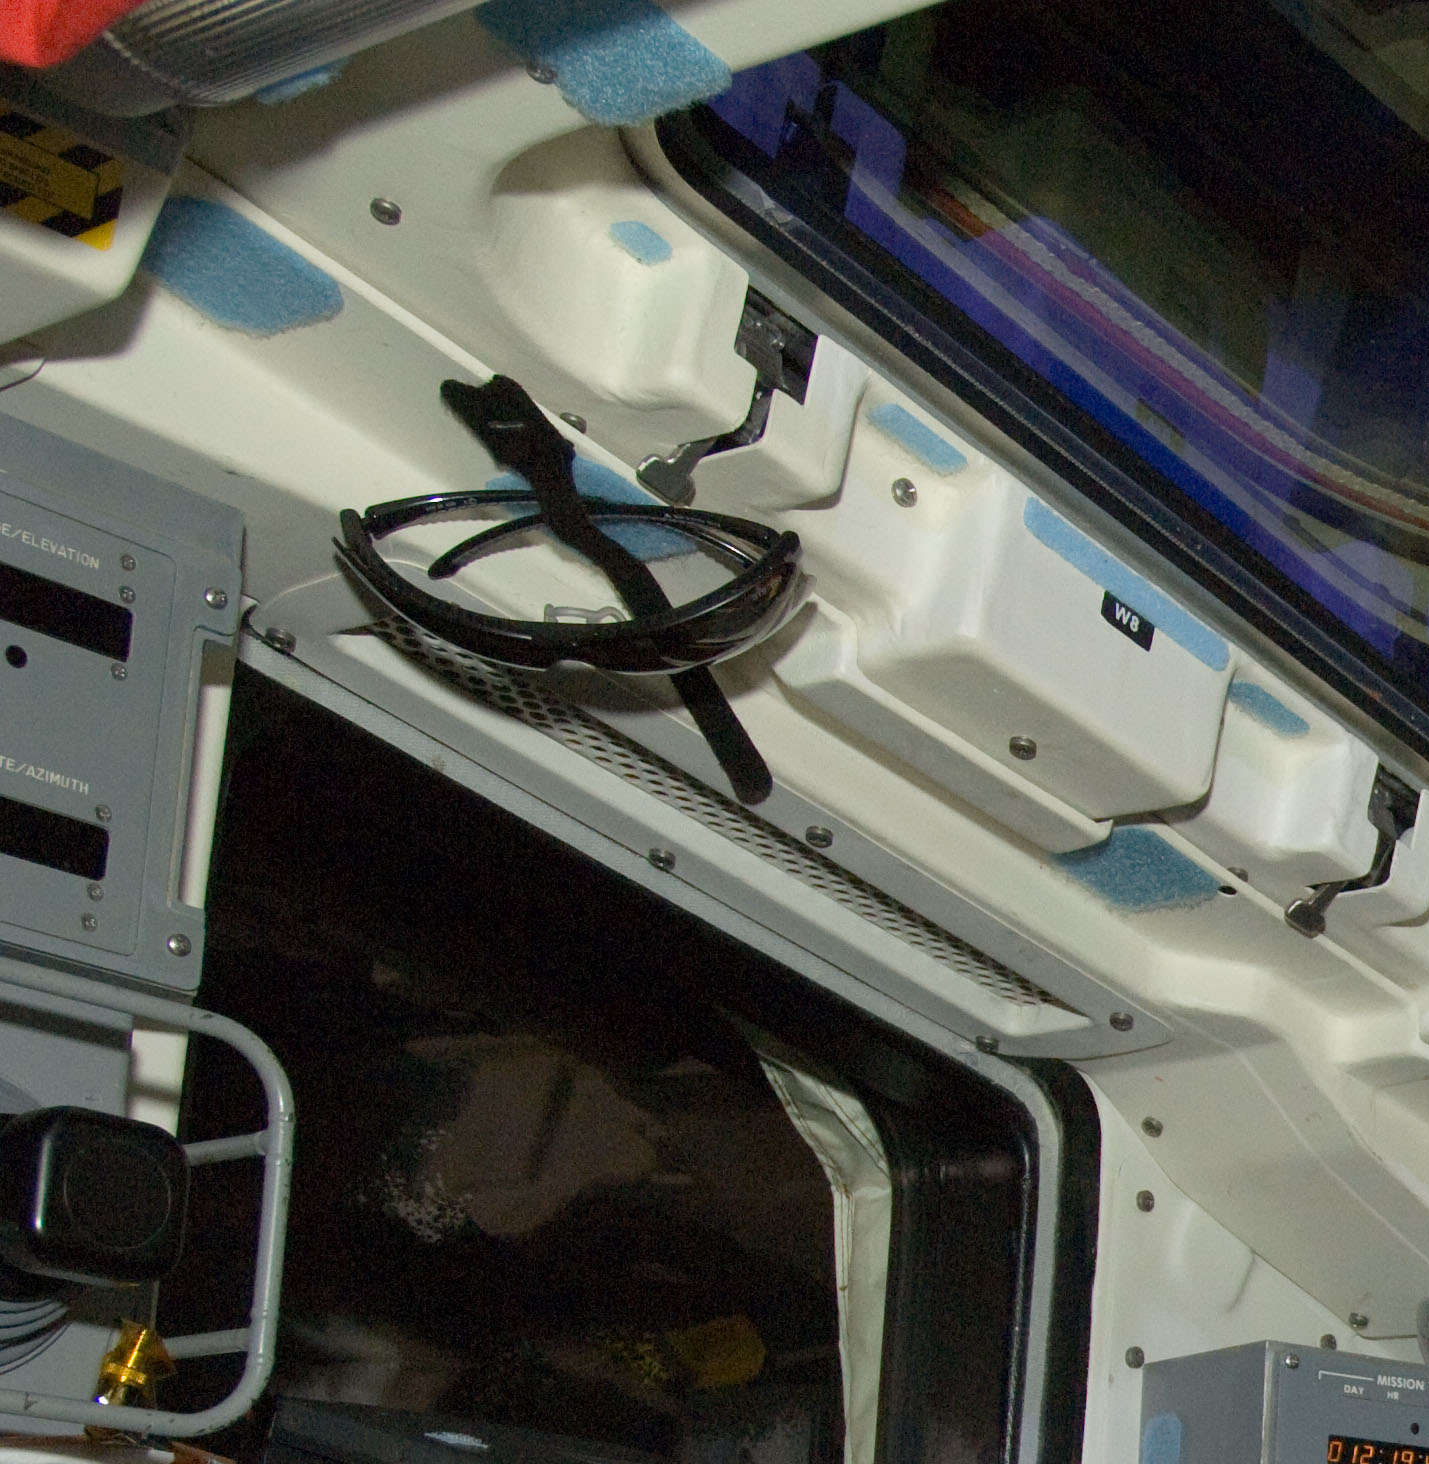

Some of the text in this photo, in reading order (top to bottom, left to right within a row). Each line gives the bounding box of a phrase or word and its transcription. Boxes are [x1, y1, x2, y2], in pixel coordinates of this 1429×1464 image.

[1115, 602, 1140, 632] W8
[1377, 1375, 1424, 1390] MISSION
[1344, 1385, 1364, 1396] DAY
